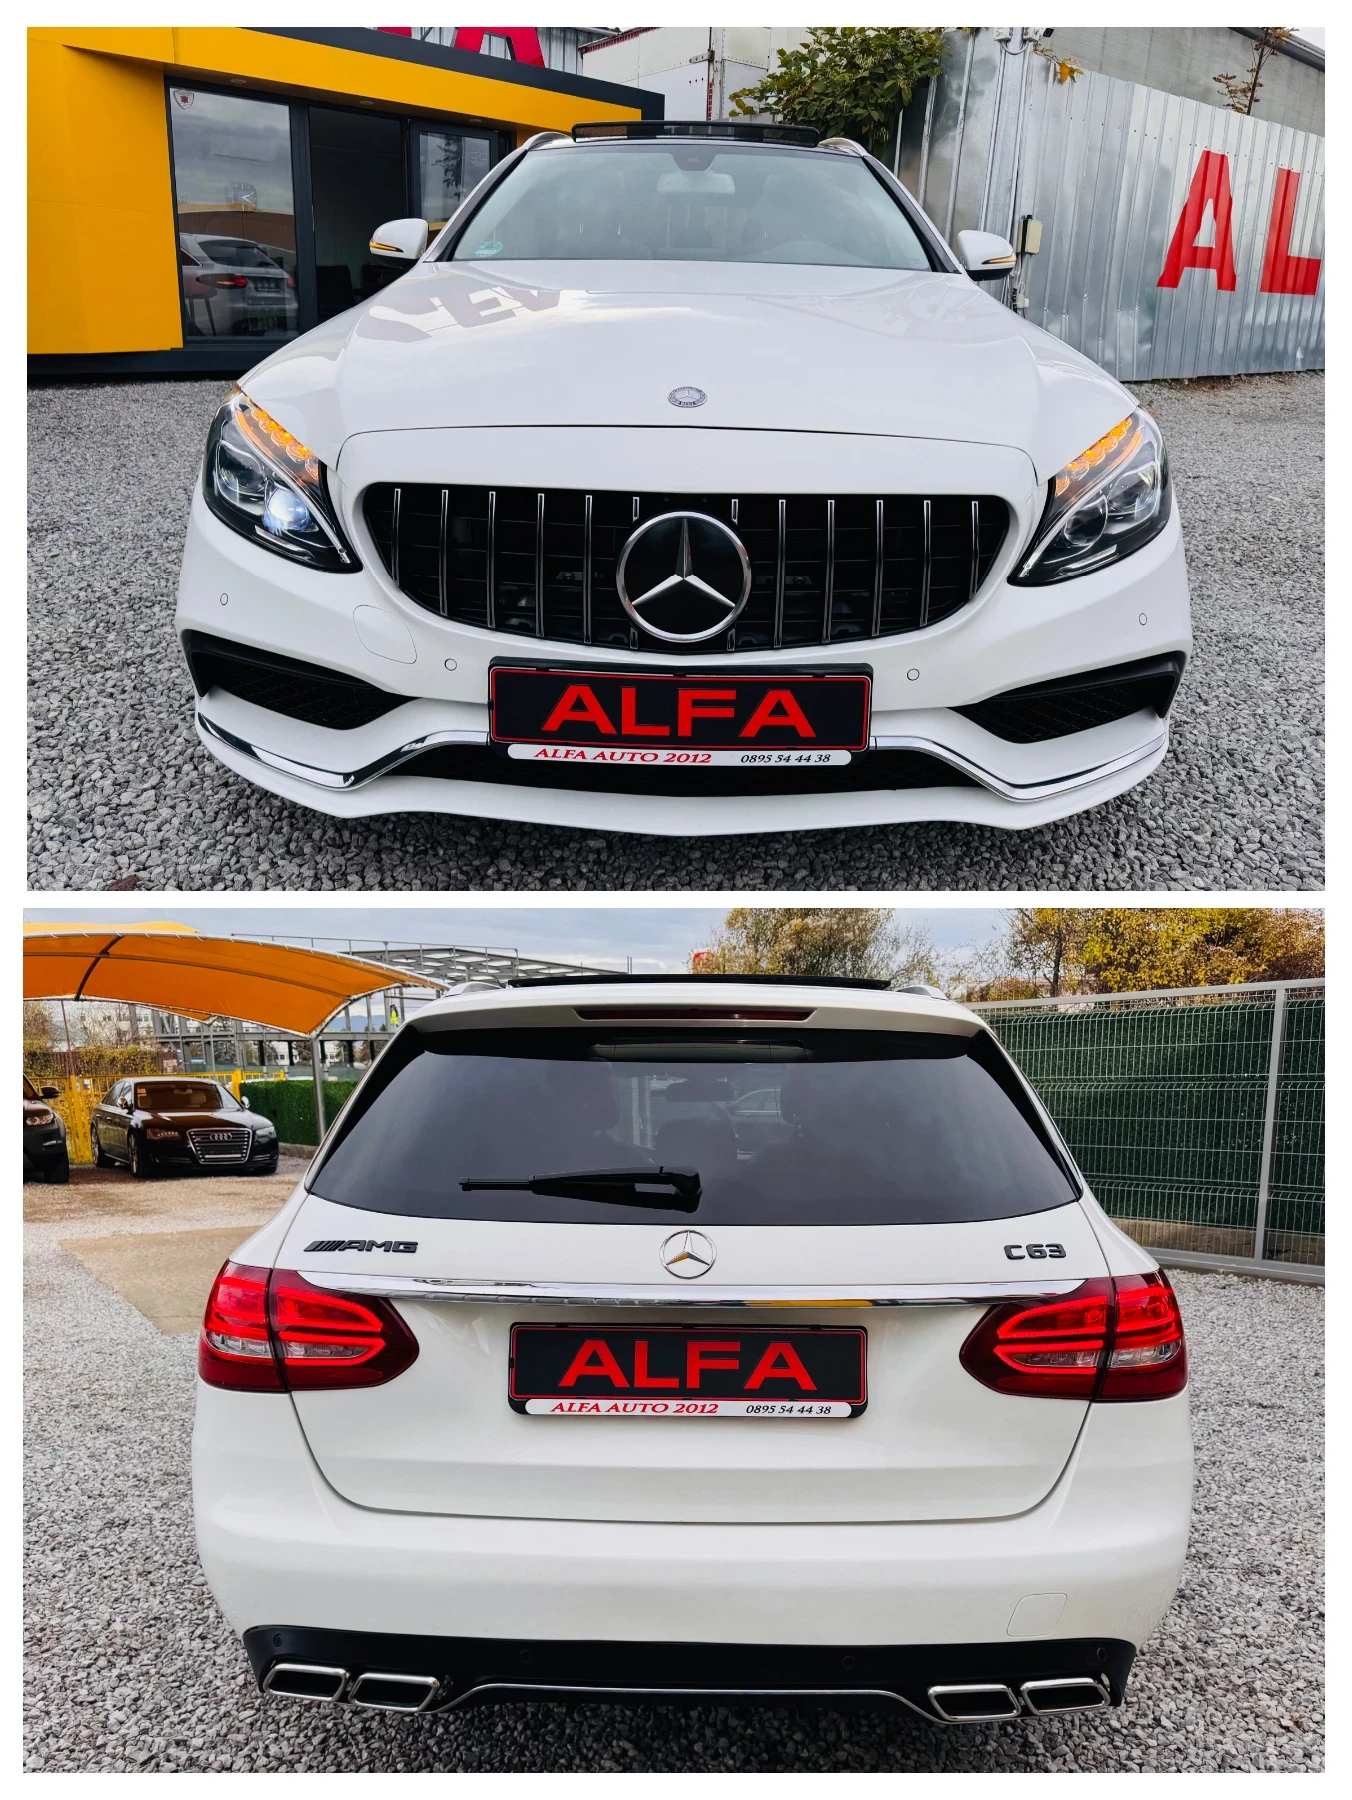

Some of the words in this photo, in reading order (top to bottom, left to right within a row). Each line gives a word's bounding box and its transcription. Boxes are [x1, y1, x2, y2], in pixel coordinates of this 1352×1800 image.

[541, 683, 817, 738] ALFA
[533, 748, 587, 760] ALFA
[591, 750, 659, 763] AUTO
[663, 752, 712, 764] 2012
[740, 754, 773, 764] 0895
[774, 754, 792, 764] 54
[794, 754, 812, 764] 44
[814, 753, 832, 764] 38
[558, 1339, 818, 1391] ALFA
[550, 1402, 601, 1413] ALFA
[605, 1403, 669, 1413] AUTO
[673, 1403, 719, 1414] 2012
[745, 1404, 777, 1414] 0895
[778, 1405, 794, 1414] 54
[796, 1405, 814, 1415] 44
[815, 1405, 832, 1415] 38
